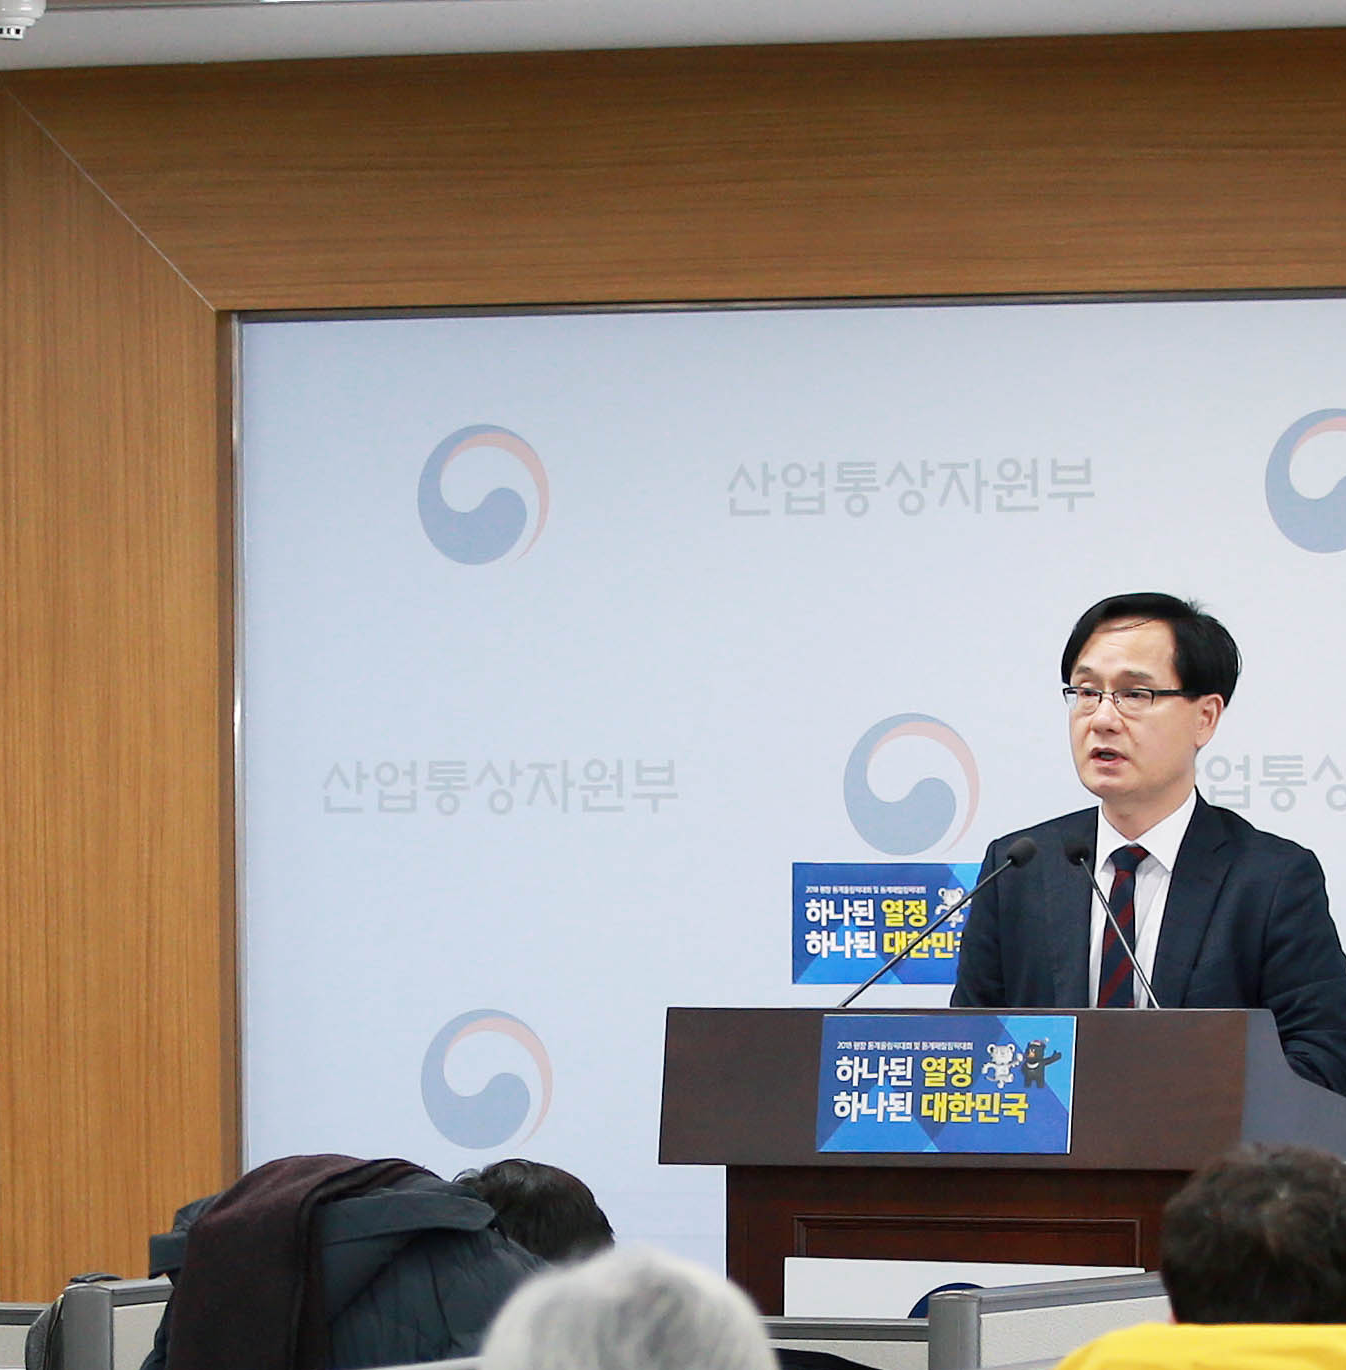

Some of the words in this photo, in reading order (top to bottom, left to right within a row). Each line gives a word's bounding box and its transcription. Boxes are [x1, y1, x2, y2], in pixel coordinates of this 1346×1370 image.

[728, 459, 1095, 517] 산업통상자원부
[322, 759, 678, 815] 산업통상자원부
[805, 899, 874, 926] 하나된
[881, 899, 927, 927] 열정
[805, 931, 877, 959] 하나된
[835, 1056, 913, 1087] 하나된
[921, 1057, 973, 1087] 열정
[833, 1091, 912, 1122] 하나된
[920, 1092, 1029, 1124] 대한민국
